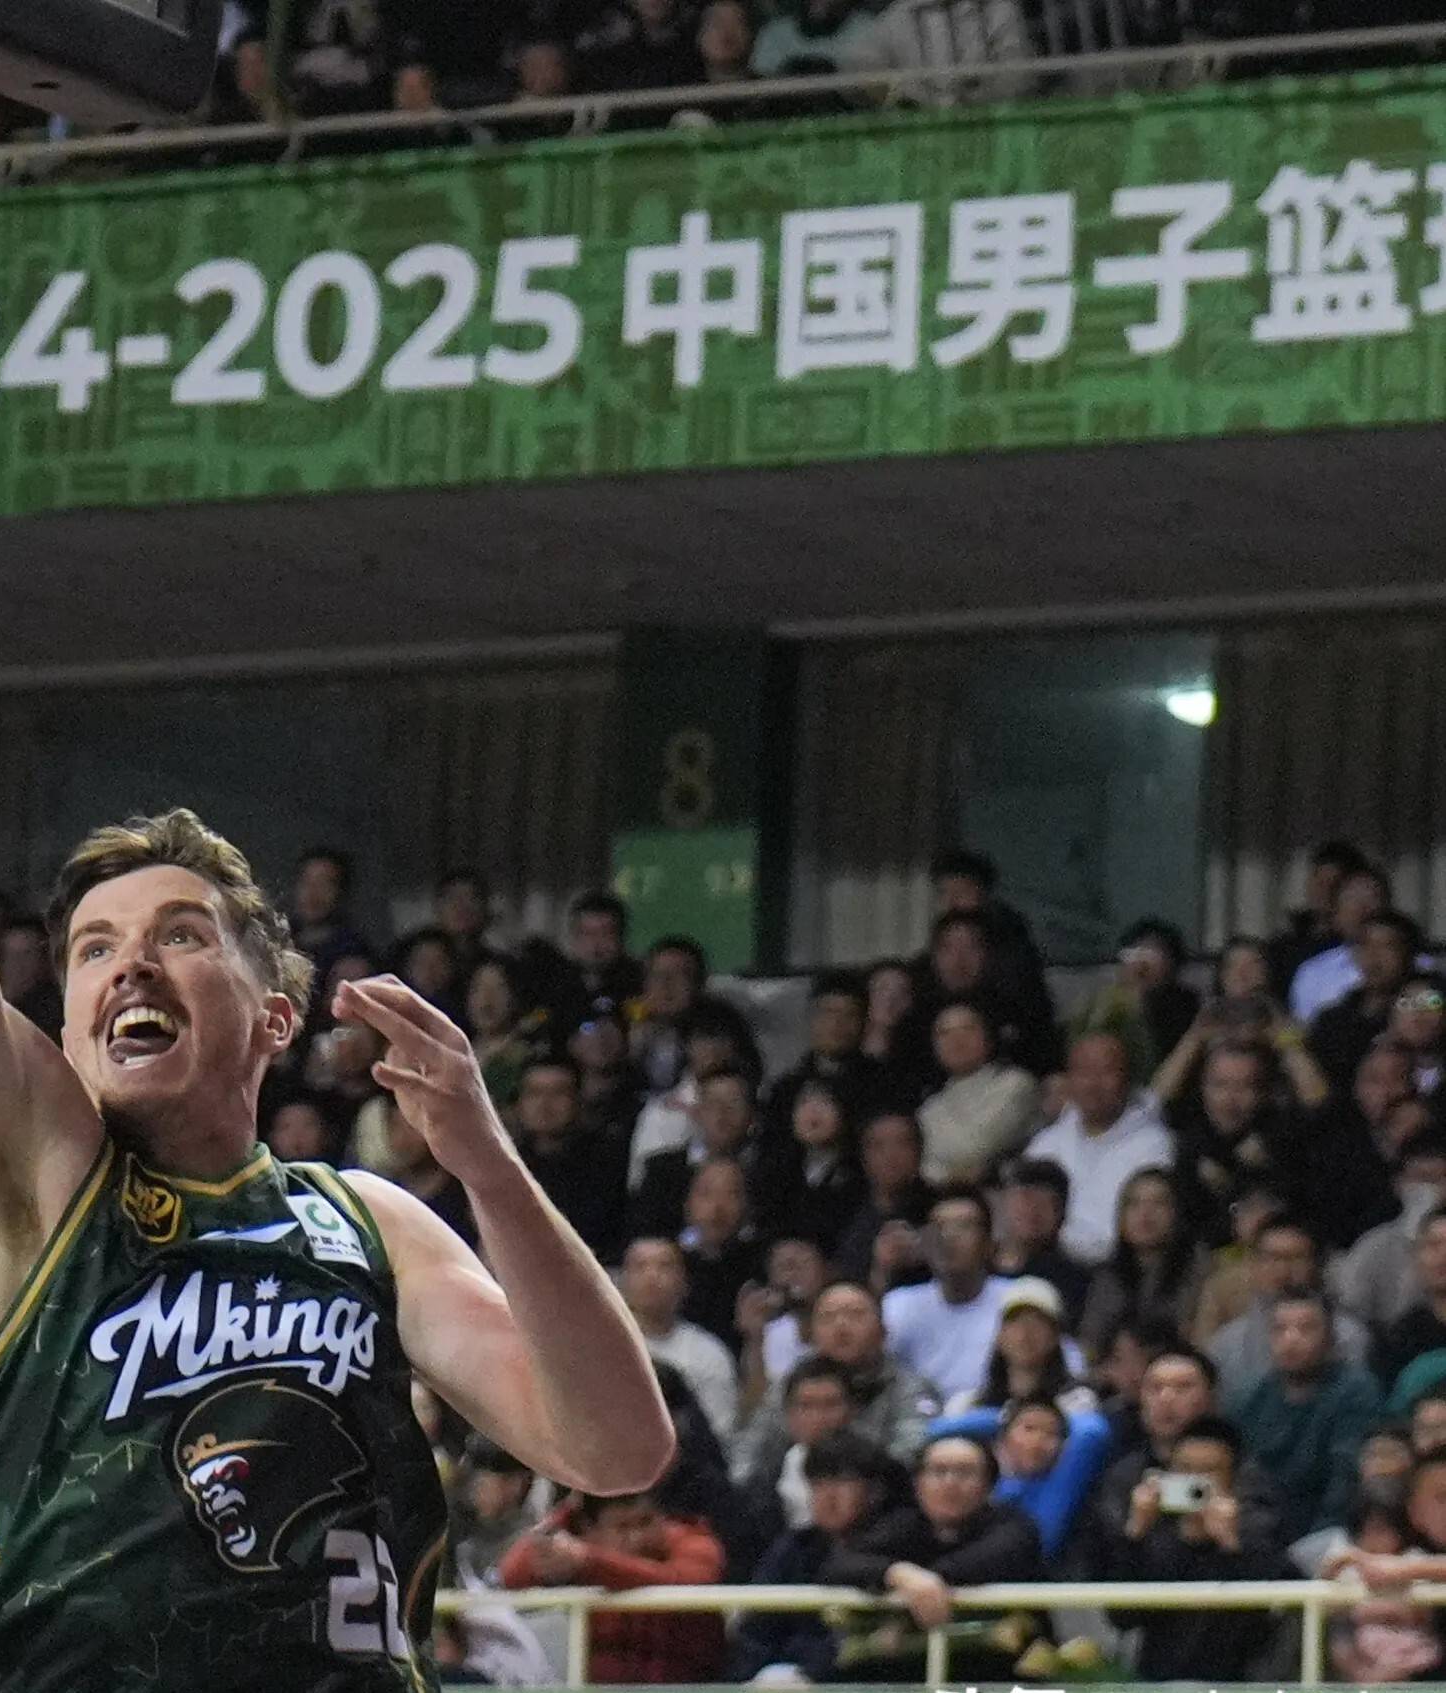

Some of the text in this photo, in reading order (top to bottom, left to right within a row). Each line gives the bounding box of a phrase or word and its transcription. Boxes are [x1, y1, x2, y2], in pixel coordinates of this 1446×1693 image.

[621, 160, 1446, 389] 中国男子篮
[661, 728, 715, 828] 8
[90, 1270, 380, 1421] Mkings
